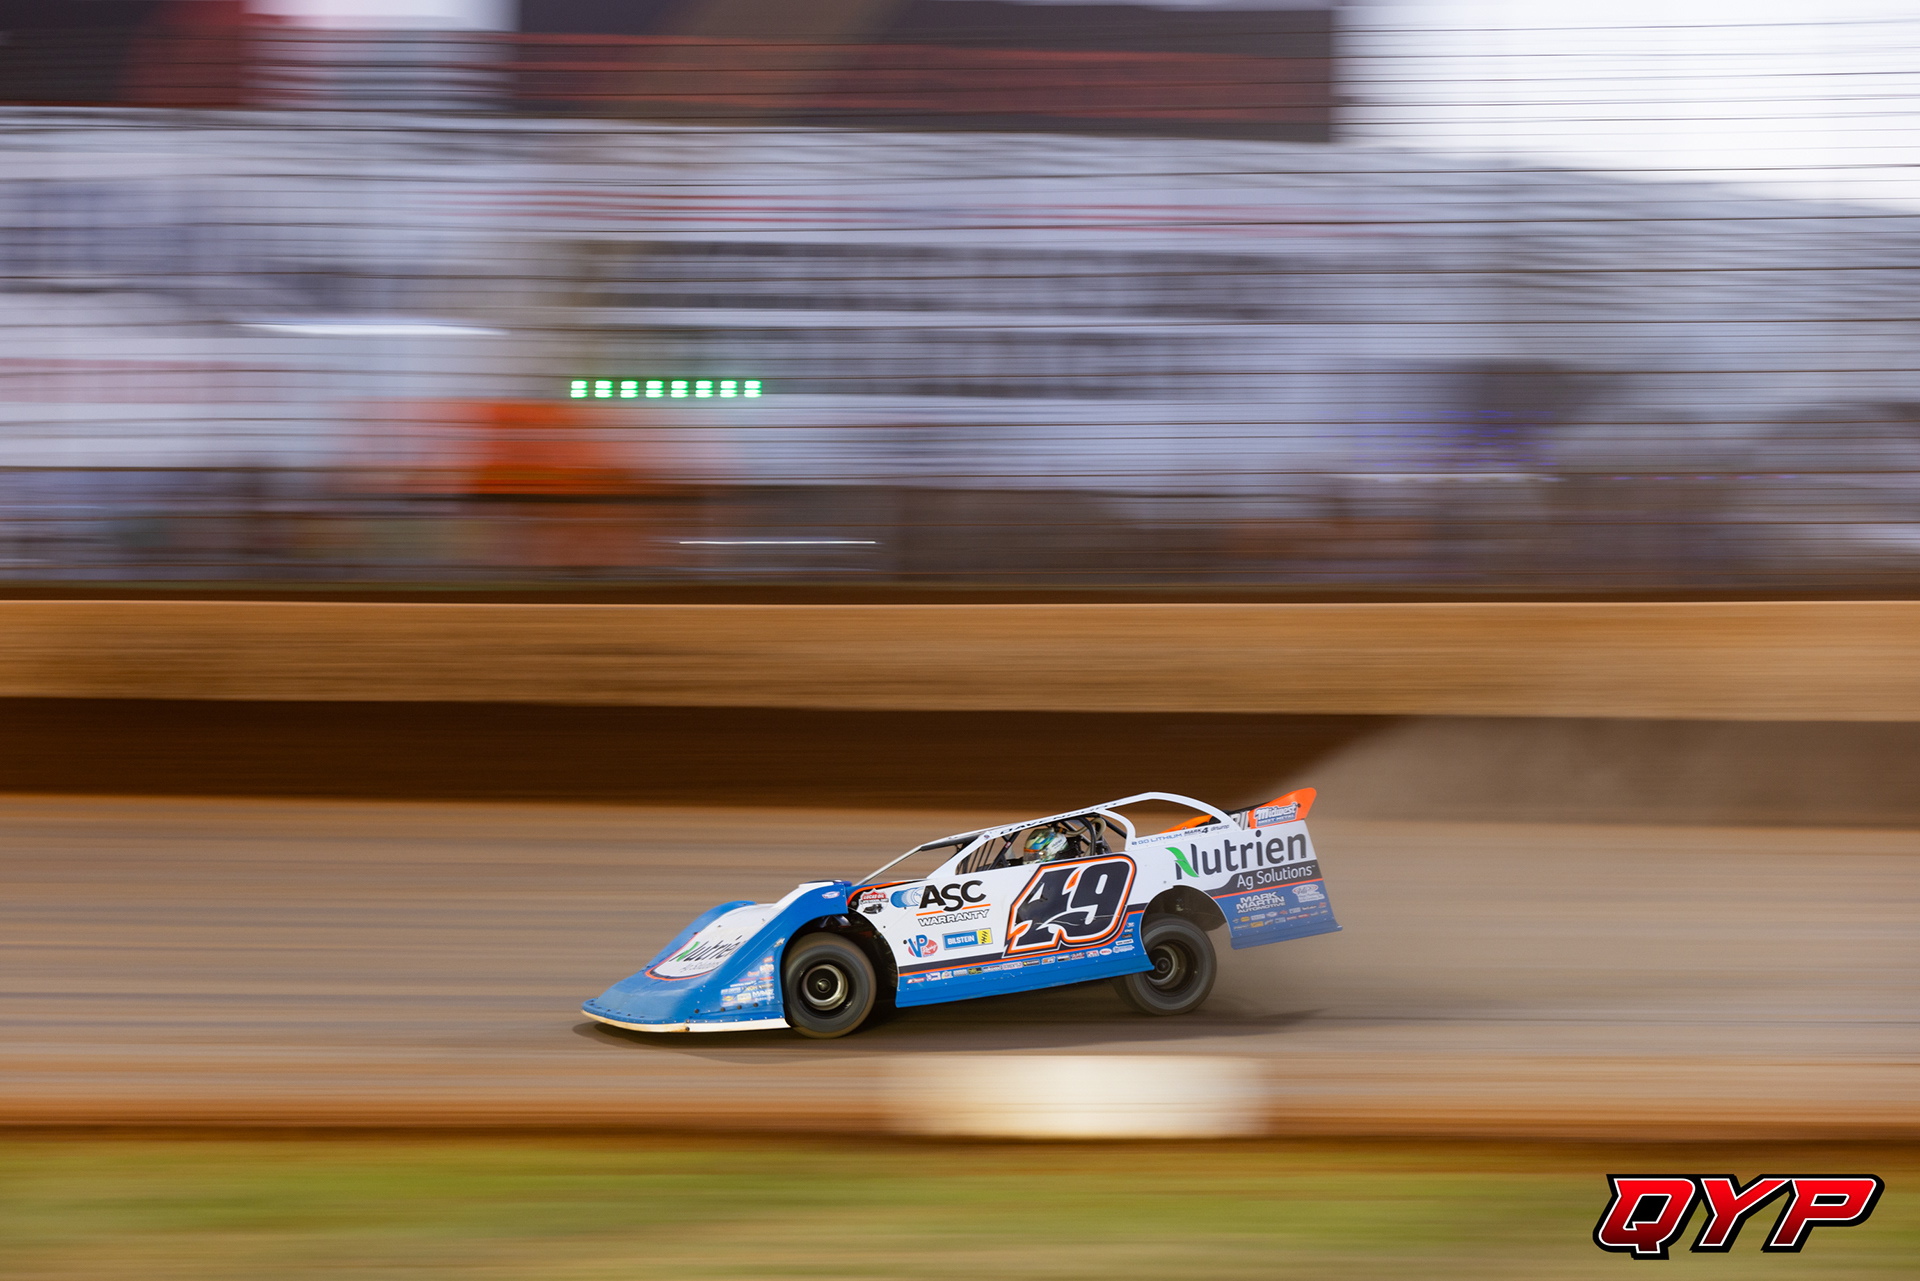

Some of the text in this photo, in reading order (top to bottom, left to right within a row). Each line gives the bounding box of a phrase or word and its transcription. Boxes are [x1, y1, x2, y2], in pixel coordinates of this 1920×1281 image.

[1255, 802, 1298, 820] Midwest
[1150, 833, 1182, 843] LITHIUM
[1165, 829, 1307, 881] Nutrien
[1236, 866, 1312, 889] Ag Solutions
[918, 880, 987, 912] ASC
[1007, 857, 1133, 953] 49
[1236, 896, 1285, 910] MARTIN
[1240, 891, 1277, 904] MARK
[1237, 902, 1286, 914] AUTOMOTIVE
[917, 909, 990, 927] WARRANTY
[907, 934, 928, 958] VP
[947, 935, 975, 946] BILSTEIN
